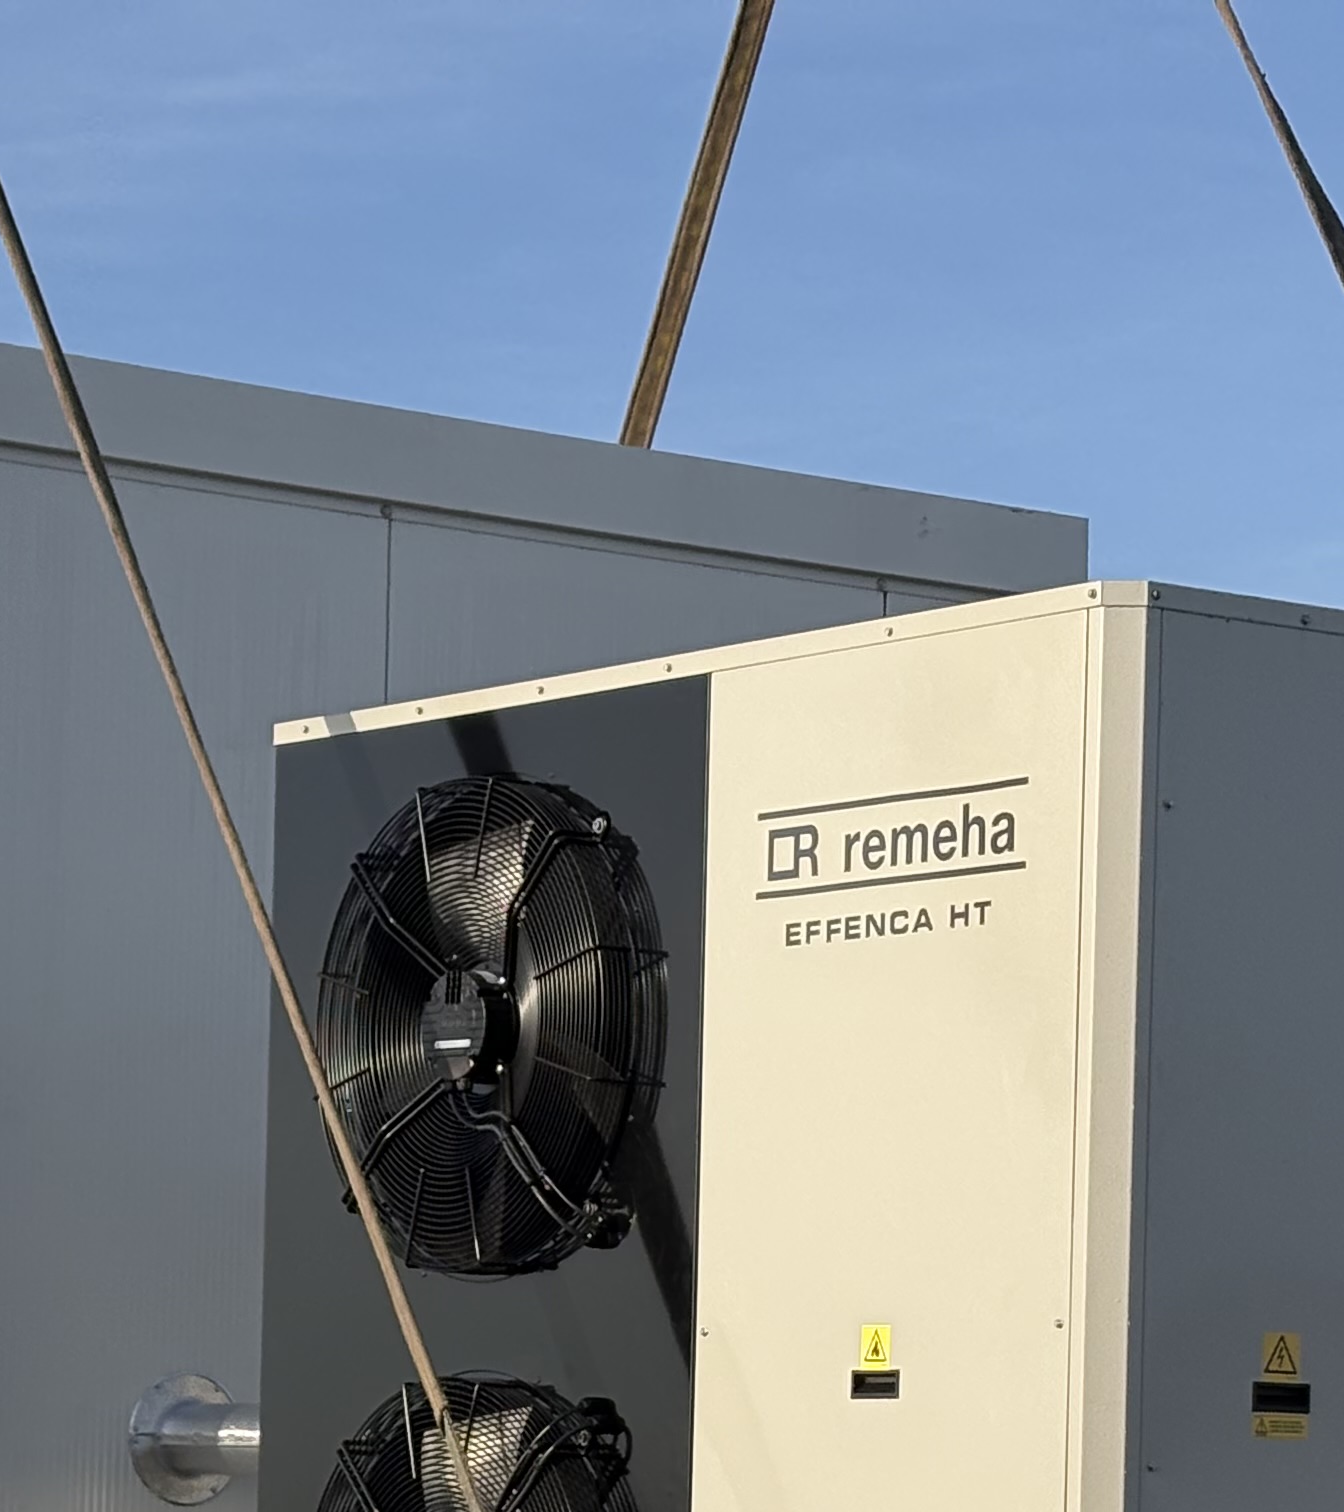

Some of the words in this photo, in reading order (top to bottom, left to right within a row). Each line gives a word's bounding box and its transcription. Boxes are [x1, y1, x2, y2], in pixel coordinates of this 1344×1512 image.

[843, 802, 1016, 873] remeha
[785, 907, 934, 947] EFFENCA
[949, 900, 992, 929] HT
